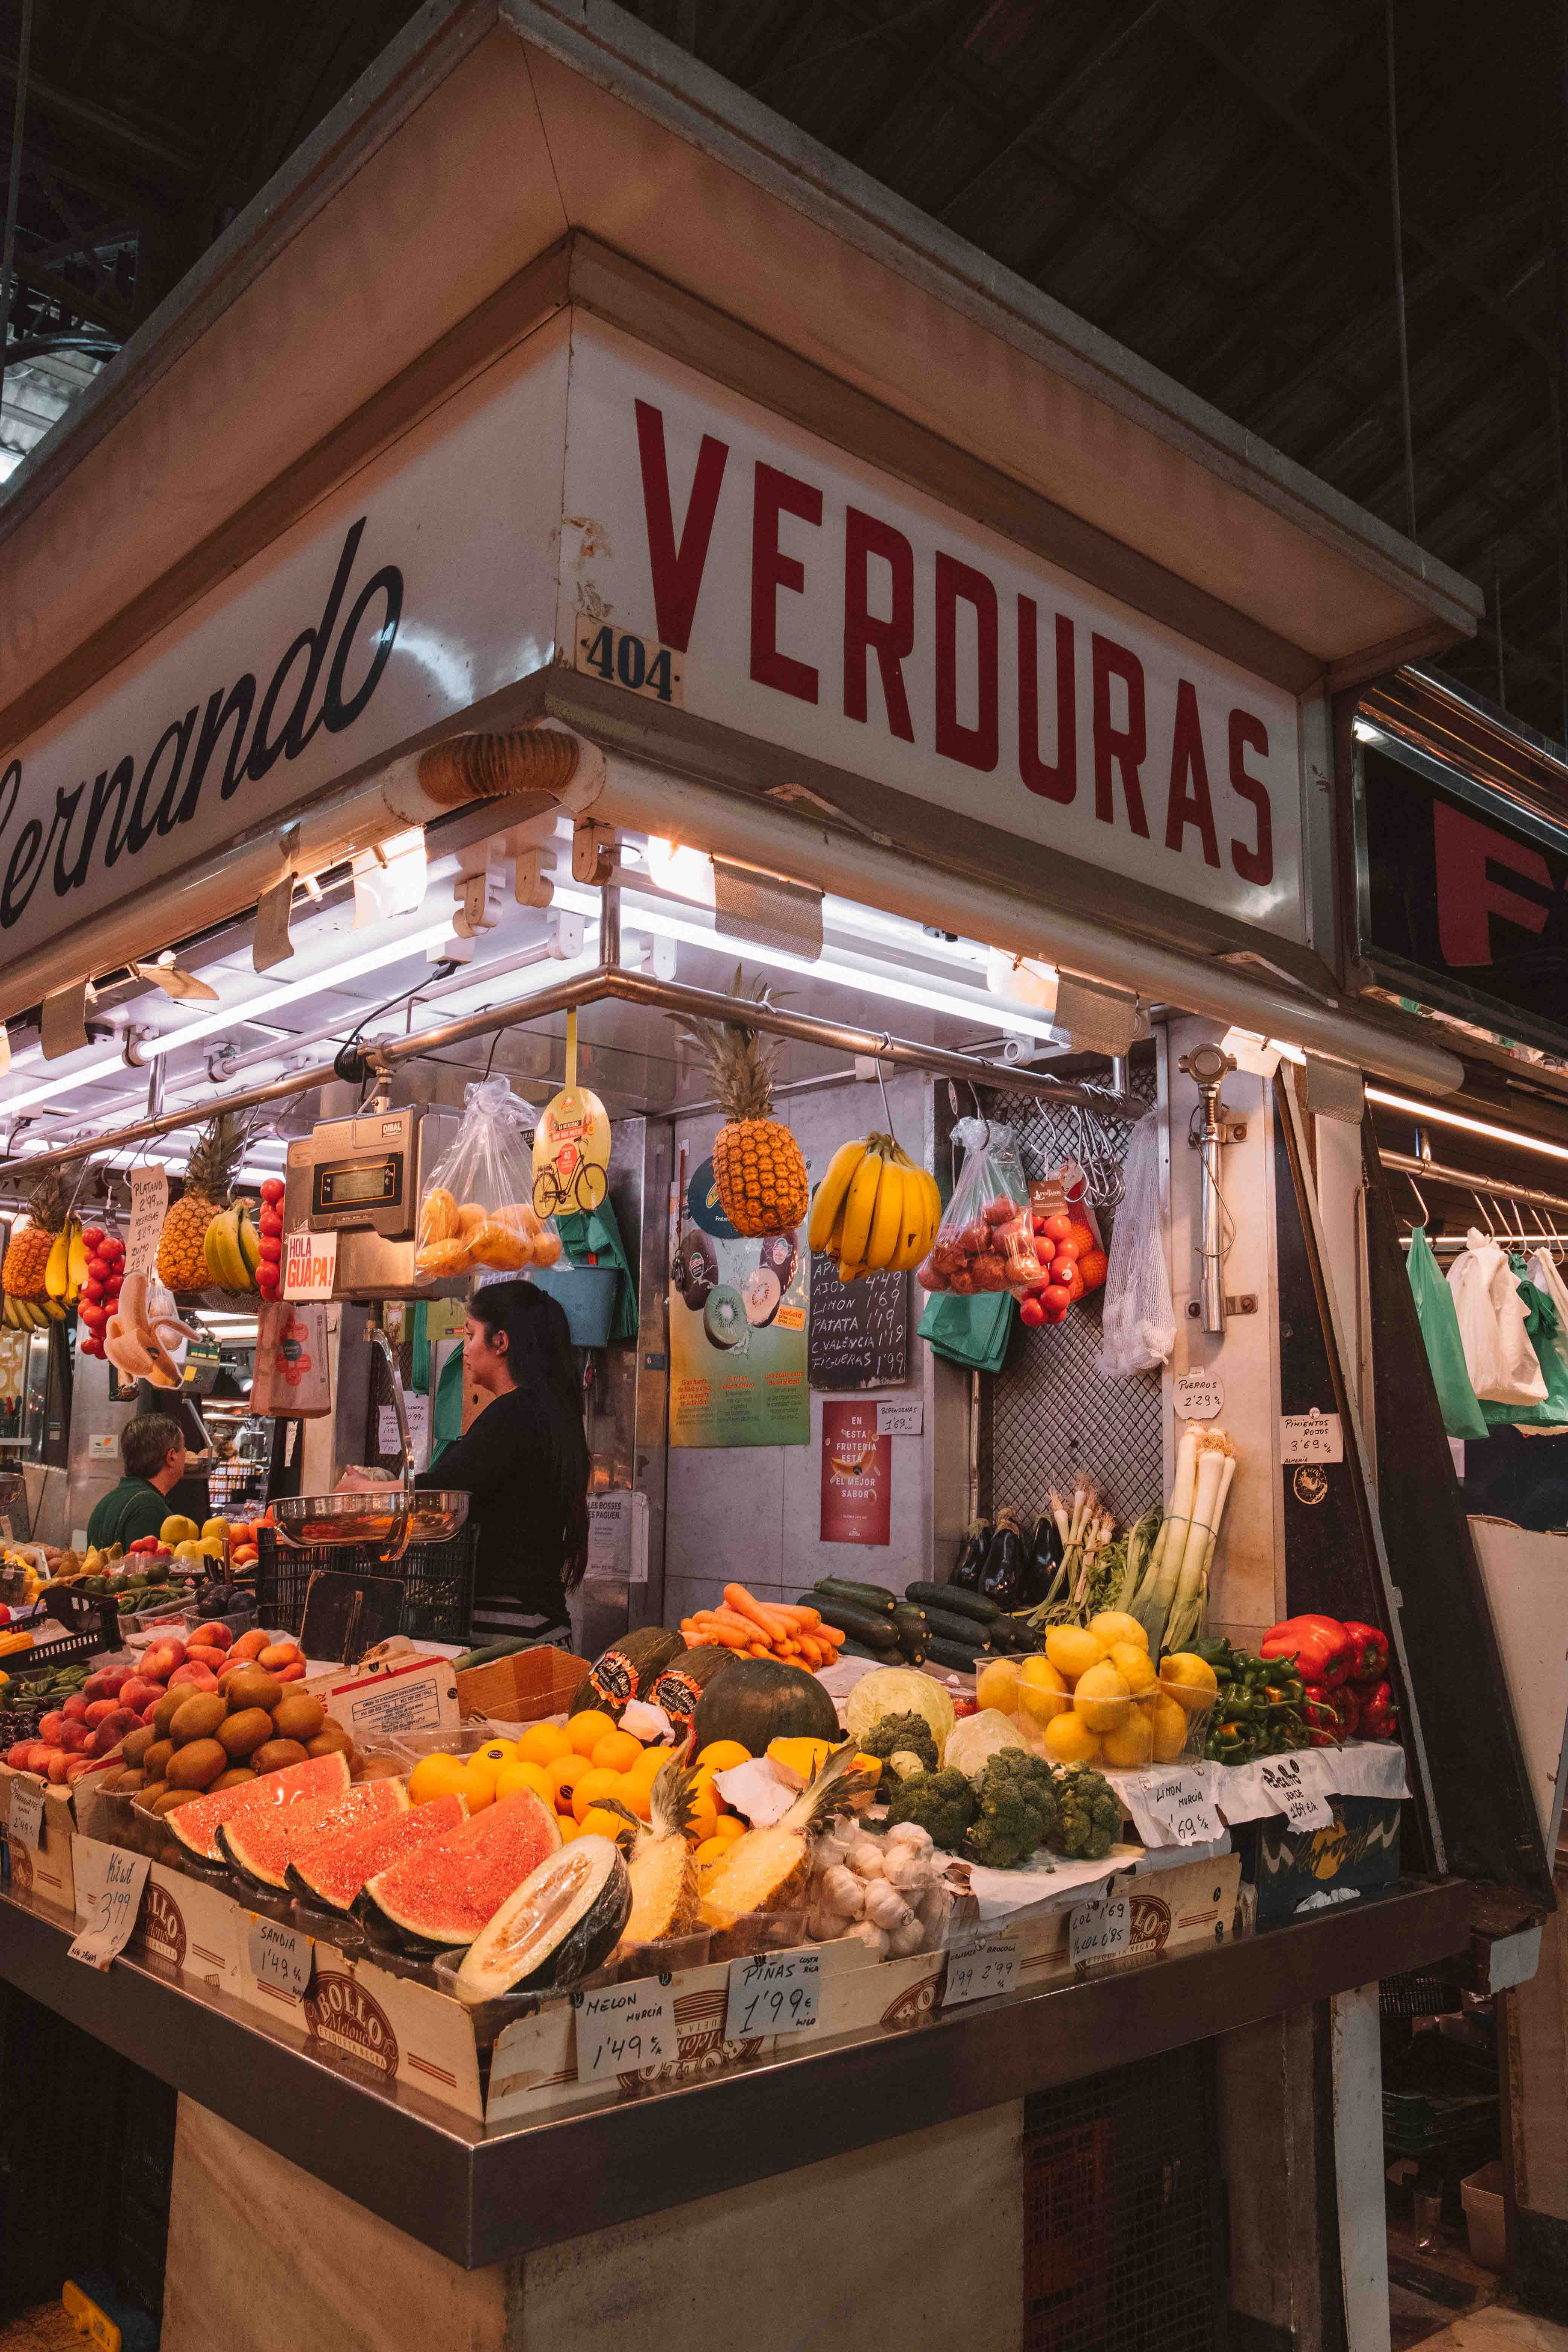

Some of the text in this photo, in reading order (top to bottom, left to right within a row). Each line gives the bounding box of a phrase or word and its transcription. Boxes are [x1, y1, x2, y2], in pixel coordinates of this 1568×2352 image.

[634, 398, 1273, 887] VERDURAS
[383, 1122, 401, 1133] DIBAL
[564, 1151, 571, 1160] 40
[289, 1237, 311, 1258] HOLA
[287, 1257, 334, 1288] GUAPA!
[813, 1288, 900, 1315] LIMON 1'69
[779, 1308, 802, 1318] SunGold
[812, 1316, 858, 1337] PATATA
[879, 1324, 903, 1346] 1'19
[812, 1352, 904, 1375] FIGUERAS 1'99
[1179, 1380, 1217, 1390] PUERROS
[1184, 1395, 1210, 1406] 2'29
[1285, 1419, 1329, 1429] PIMIENTOS
[836, 1441, 877, 1451] FRUTERÍA
[1291, 1439, 1320, 1451] 3'69
[841, 1453, 862, 1462] ESTÁ
[848, 1478, 875, 1486] MEJOR
[841, 1490, 869, 1498] SABOR
[596, 1511, 622, 1520] PAGUEN.
[599, 1502, 622, 1510] BOSSES
[1156, 1782, 1181, 1802] LIMON
[1179, 1788, 1204, 1808] MURCIA
[1283, 1789, 1304, 1801] VERDE
[1290, 1802, 1306, 1819] 1'69
[106, 1852, 136, 1885] Kiwi
[90, 1891, 131, 1936] 3'99
[147, 1891, 178, 1939] LLO
[1100, 1902, 1124, 1919] 1'69
[260, 1926, 296, 1952] SANDIA
[1101, 1927, 1124, 1946] 0'85
[1131, 1942, 1154, 1952] NEGRA
[262, 1948, 288, 1980] 1'49
[742, 1962, 796, 1986] PIÑAS
[949, 1962, 1013, 1991] 1'99 2'99
[586, 1993, 637, 2016] MELON
[626, 2003, 662, 2022] MURCIA
[739, 1988, 804, 2034] 1'99
[316, 1981, 383, 2049] BOLLO
[320, 2027, 385, 2067] ETIQUETA NEGRA
[593, 2036, 642, 2069] 1'49
